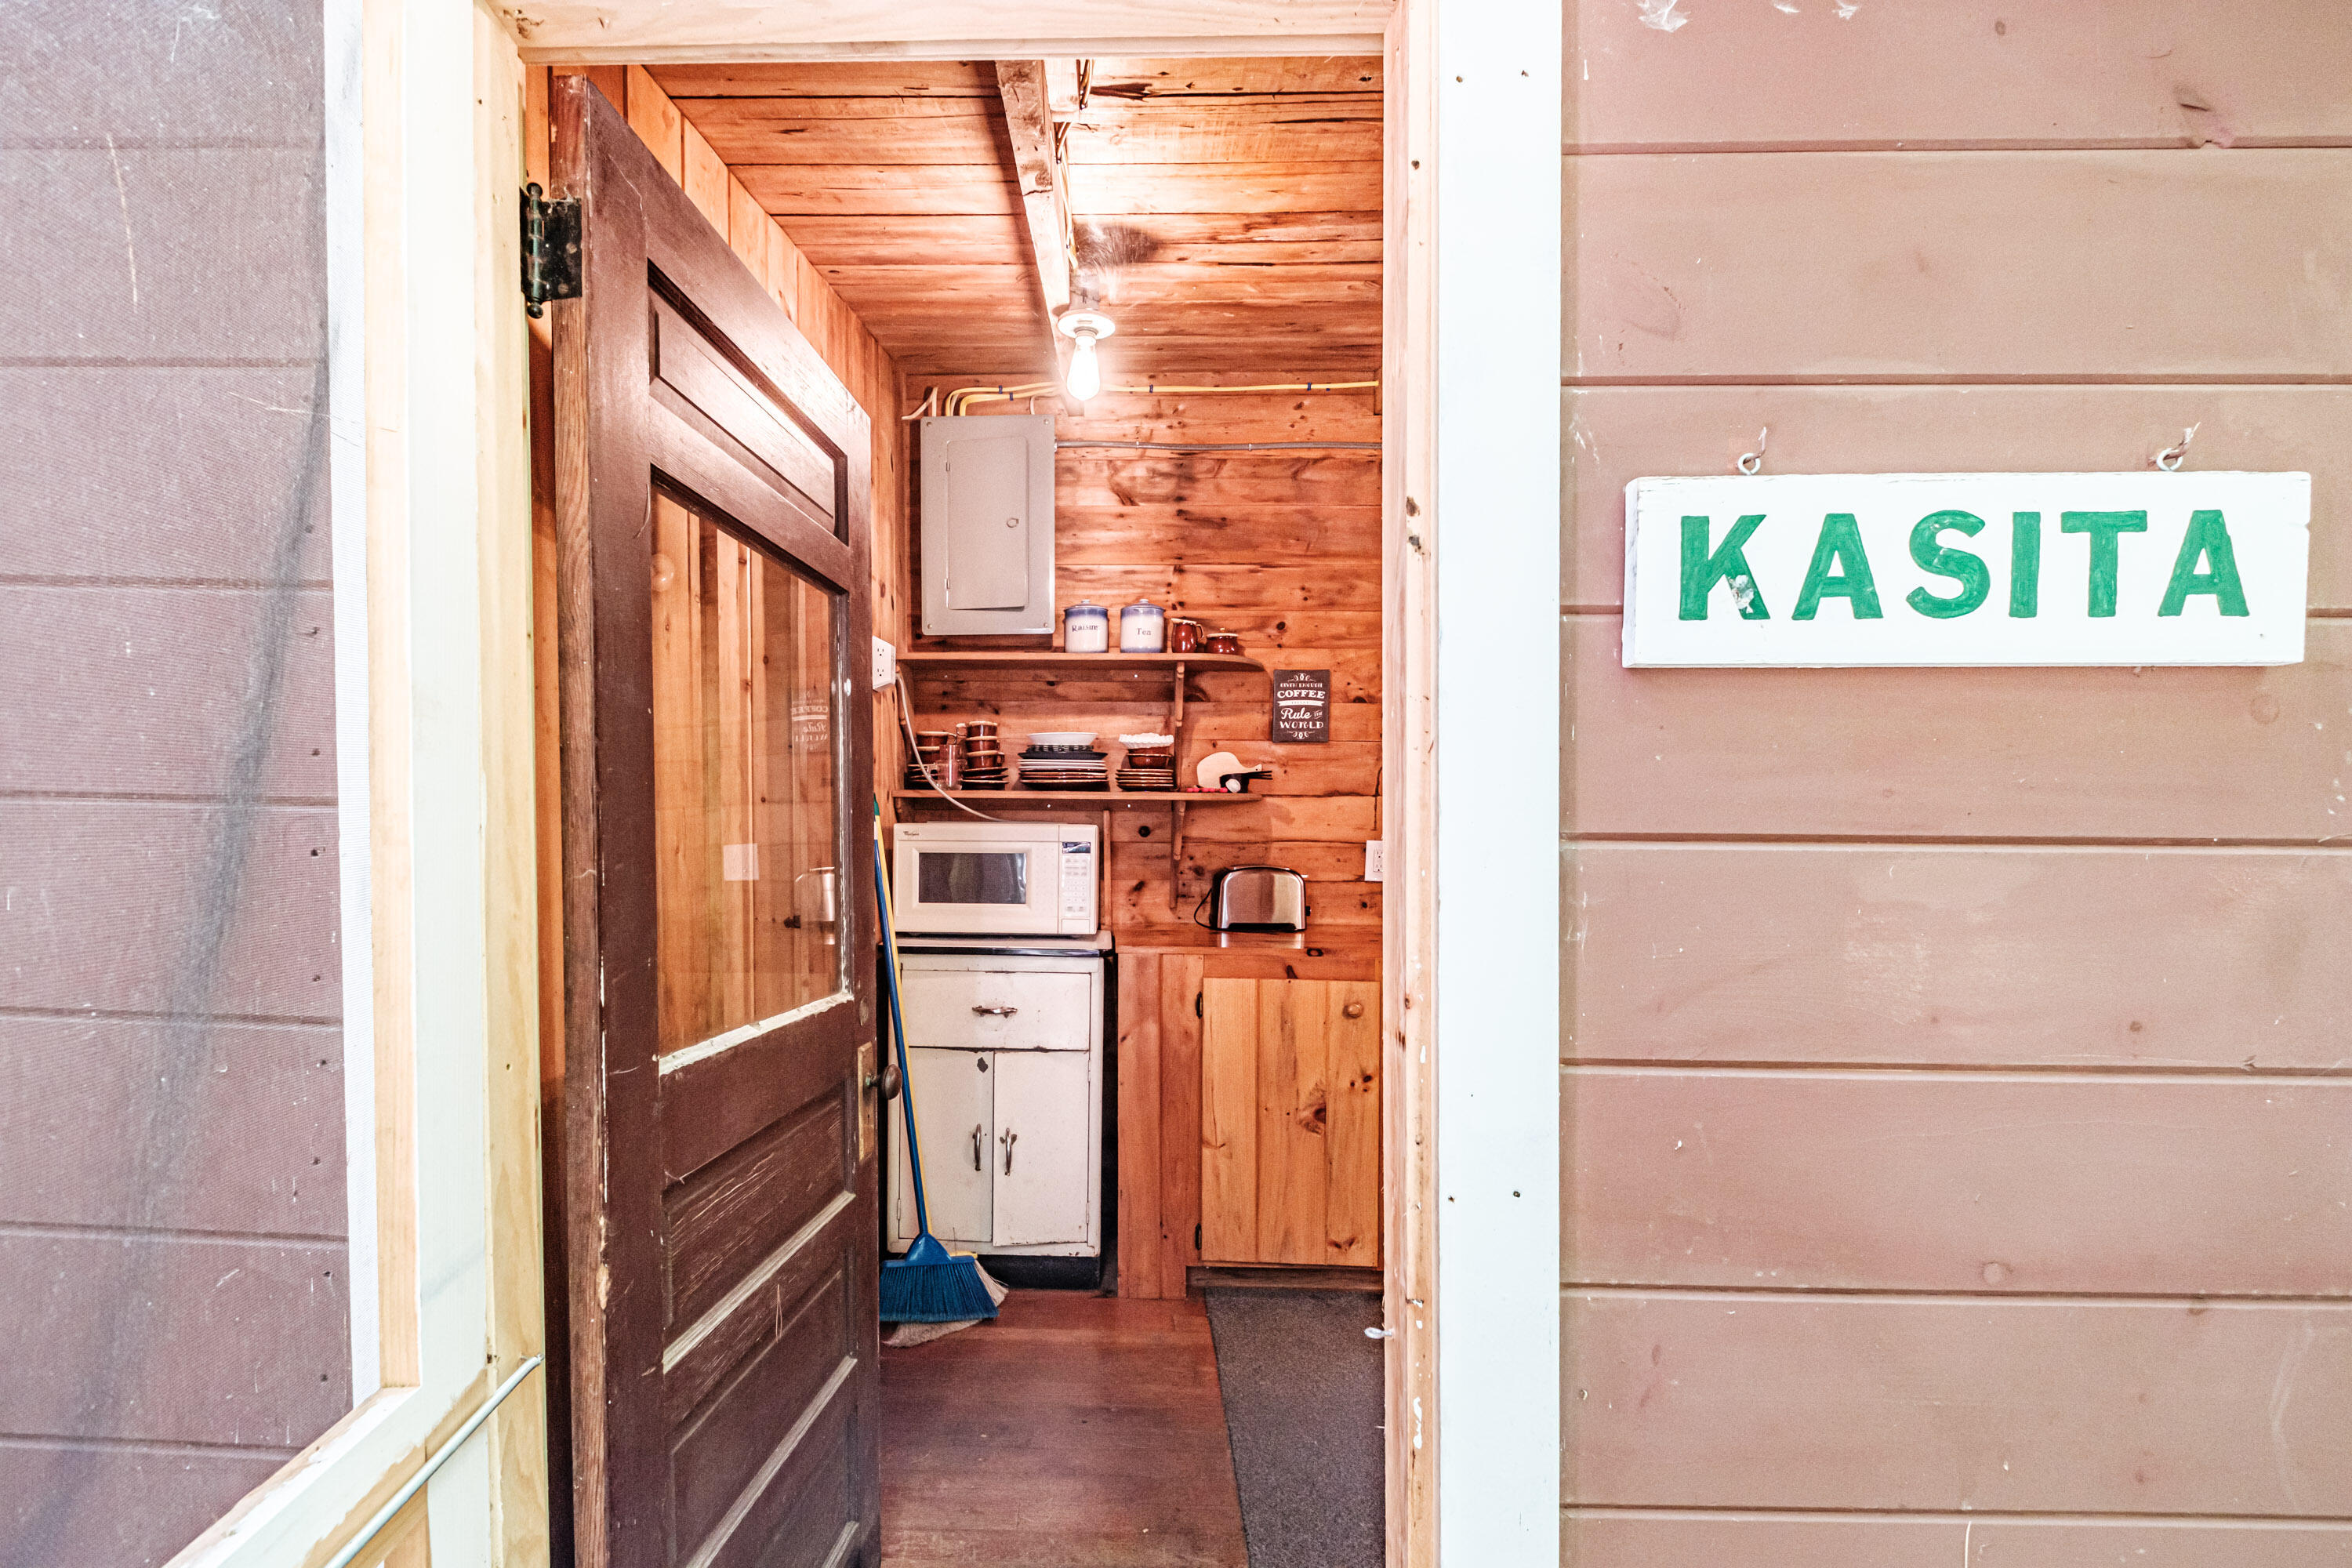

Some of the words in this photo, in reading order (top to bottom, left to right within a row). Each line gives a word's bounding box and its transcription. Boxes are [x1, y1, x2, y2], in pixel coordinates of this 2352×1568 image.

[1679, 510, 2249, 621] KASITA
[1072, 624, 1098, 633] Raisins
[1277, 690, 1326, 699] COFFEE
[1280, 707, 1312, 720] Rule
